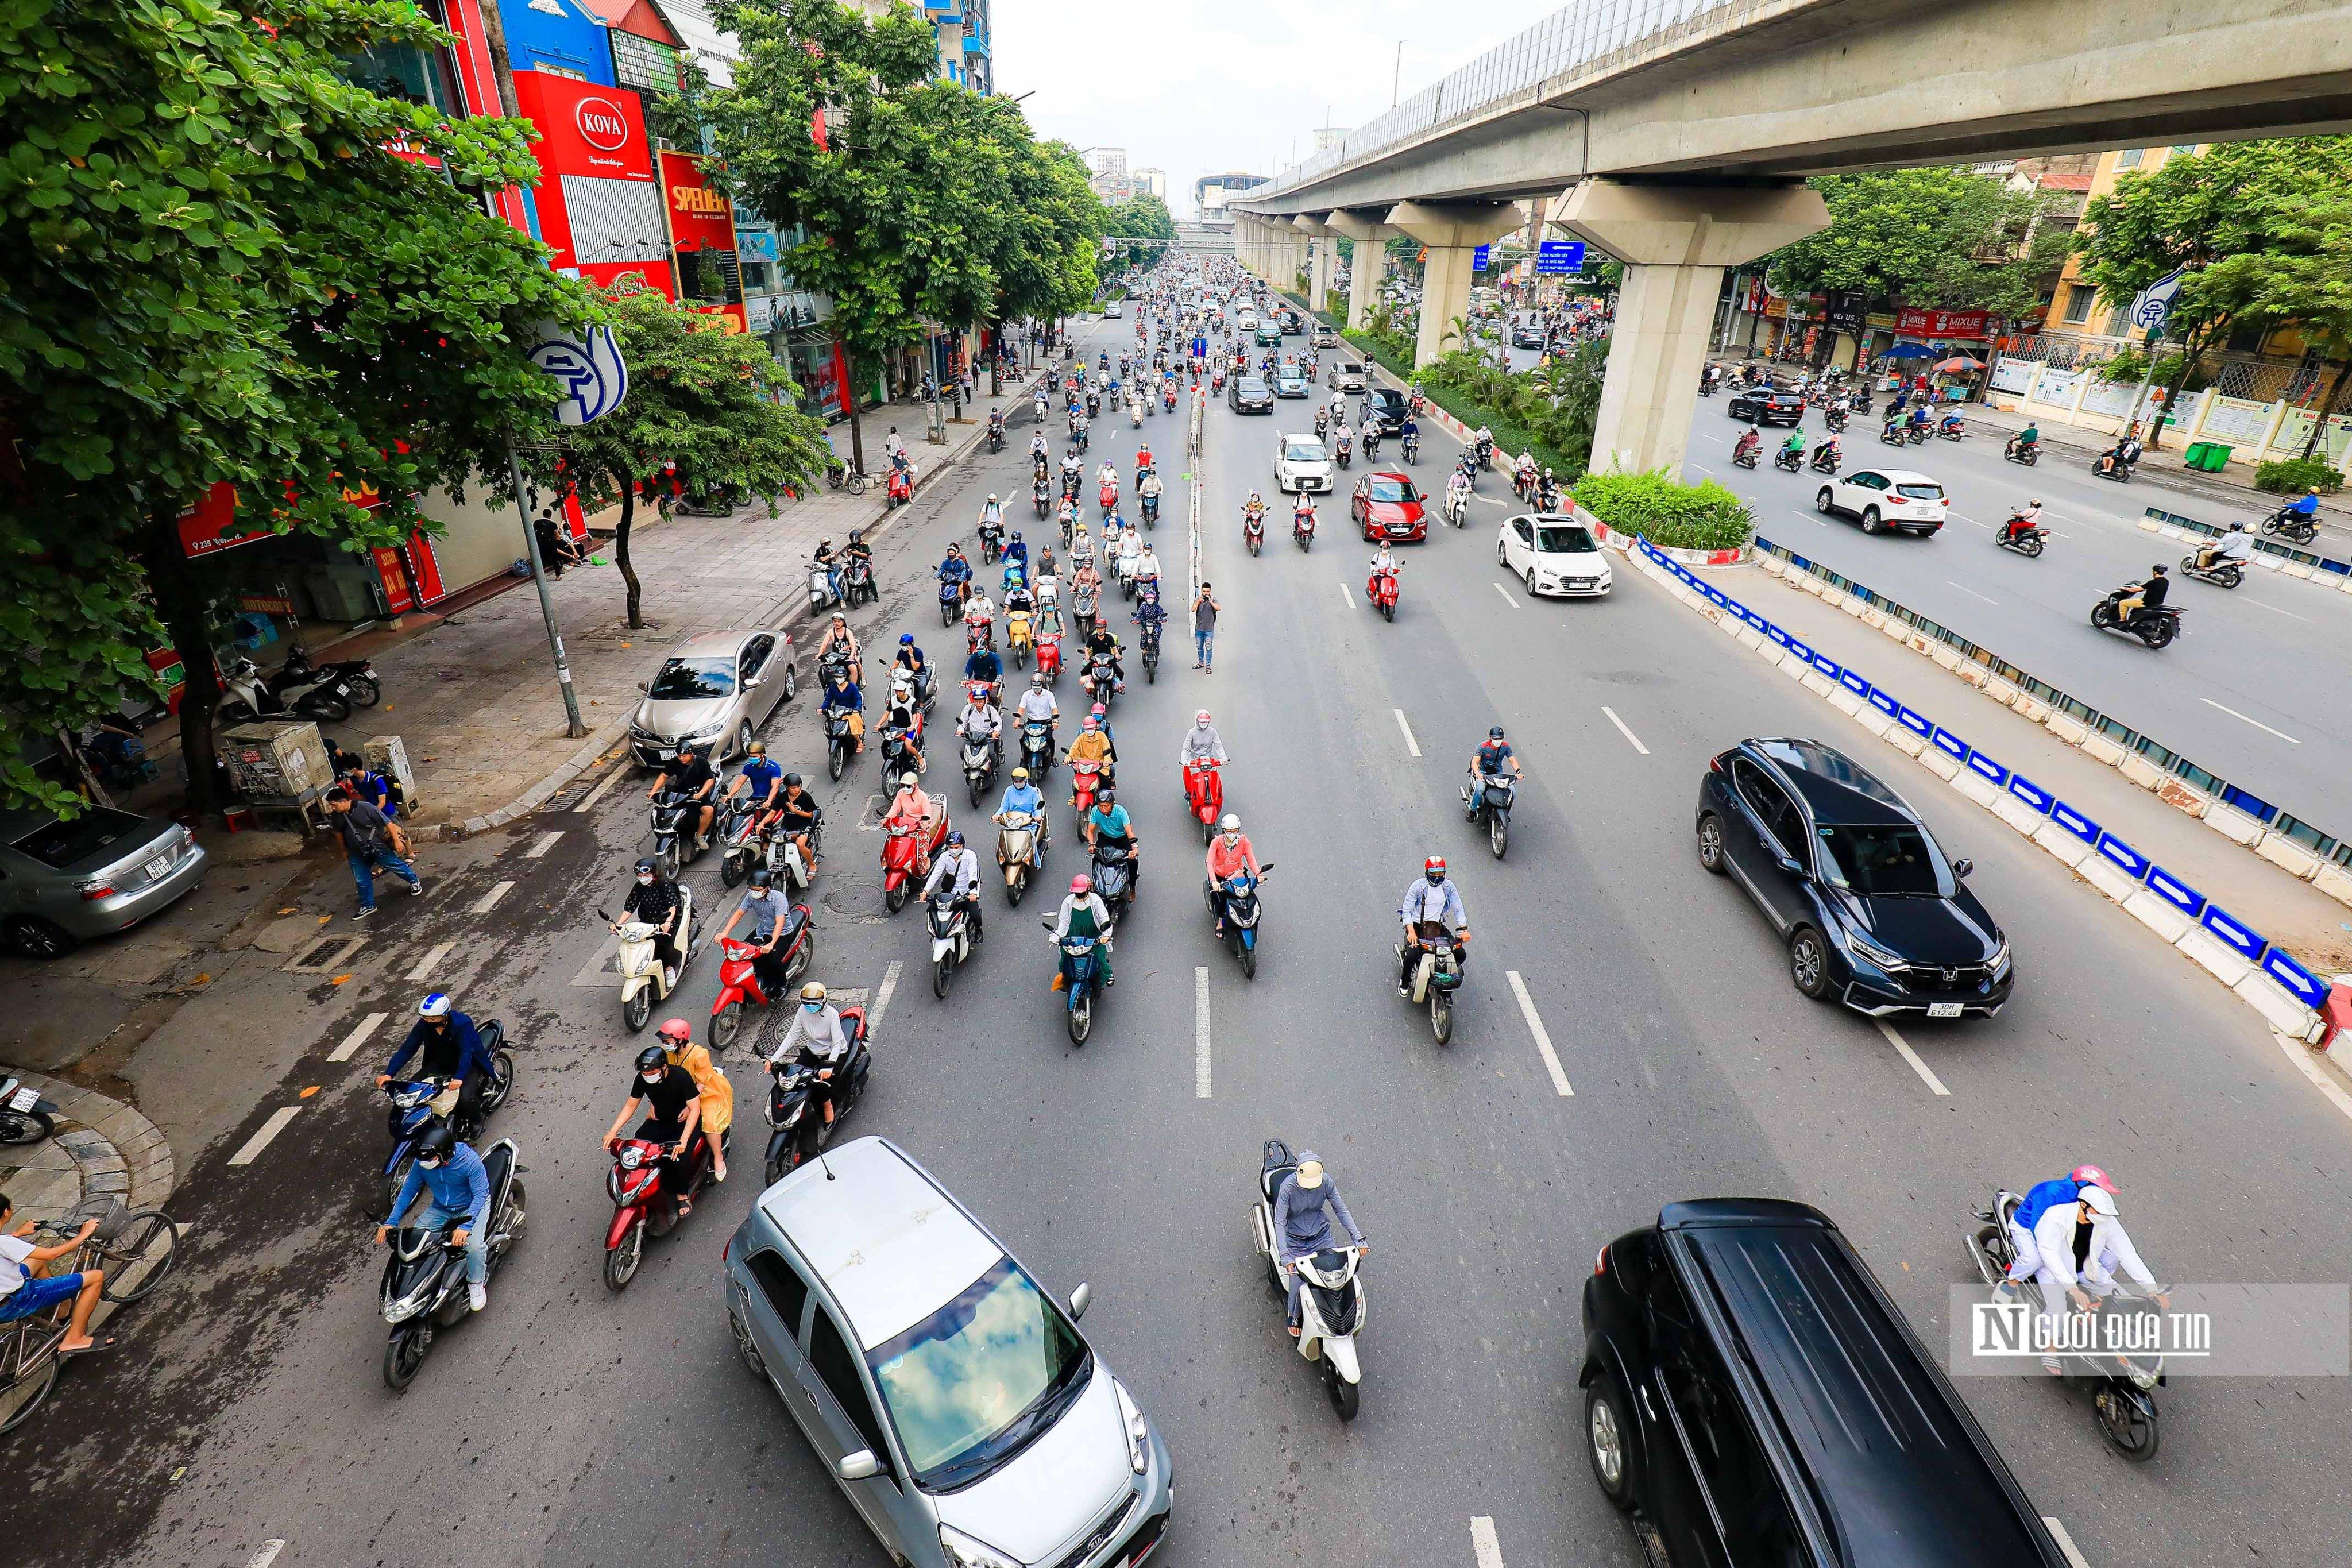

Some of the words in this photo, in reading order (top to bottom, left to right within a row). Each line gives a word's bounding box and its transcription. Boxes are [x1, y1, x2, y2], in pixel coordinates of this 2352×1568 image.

[583, 113, 622, 135] KOVA
[1907, 315, 1927, 325] MIXUE
[1949, 318, 1982, 326] MIXUE
[199, 540, 211, 549] 239
[381, 550, 397, 567] SCAN
[384, 574, 397, 596] A4
[150, 859, 163, 870] 88A
[1090, 1536, 1102, 1549] KIA
